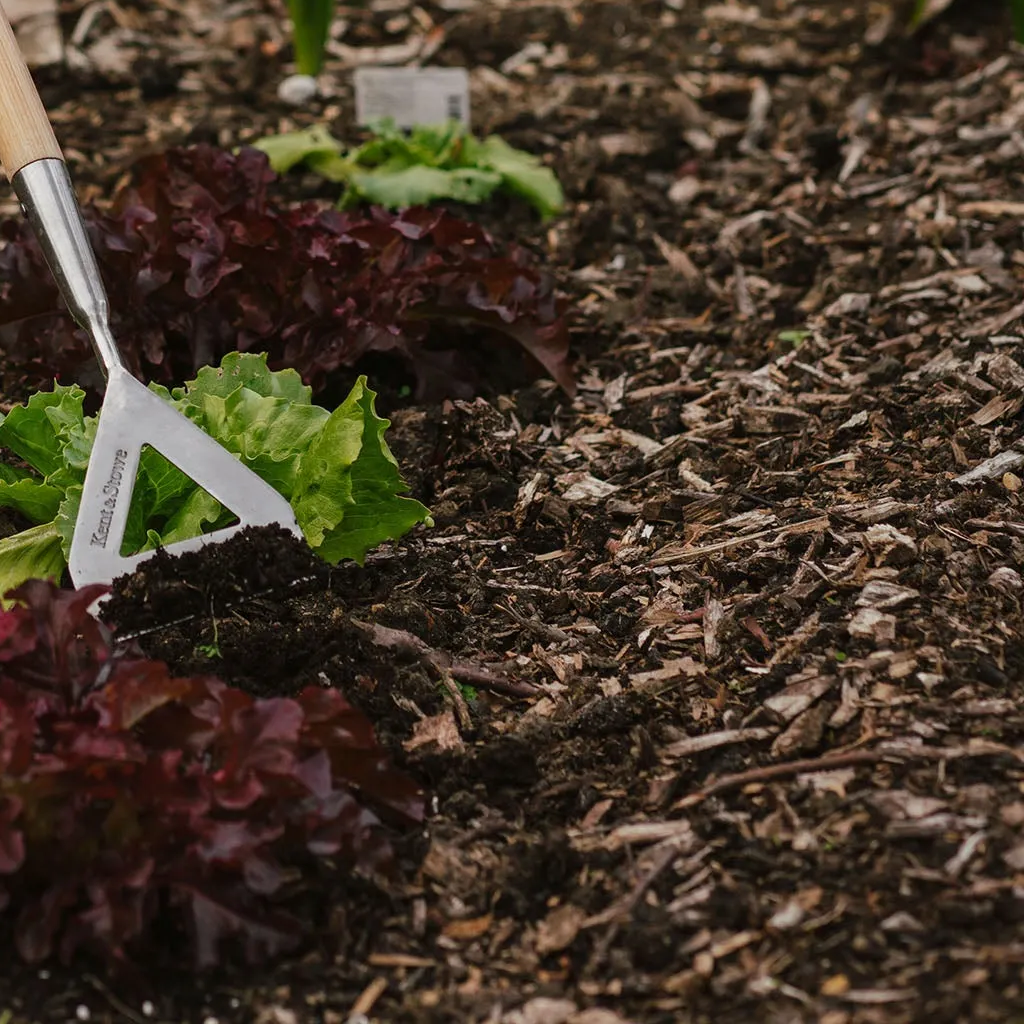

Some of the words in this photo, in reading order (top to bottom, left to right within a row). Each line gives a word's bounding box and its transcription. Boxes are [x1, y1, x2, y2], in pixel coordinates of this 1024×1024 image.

[103, 449, 128, 497] Stowe
[105, 497, 116, 509] &
[90, 509, 114, 549] Kent
